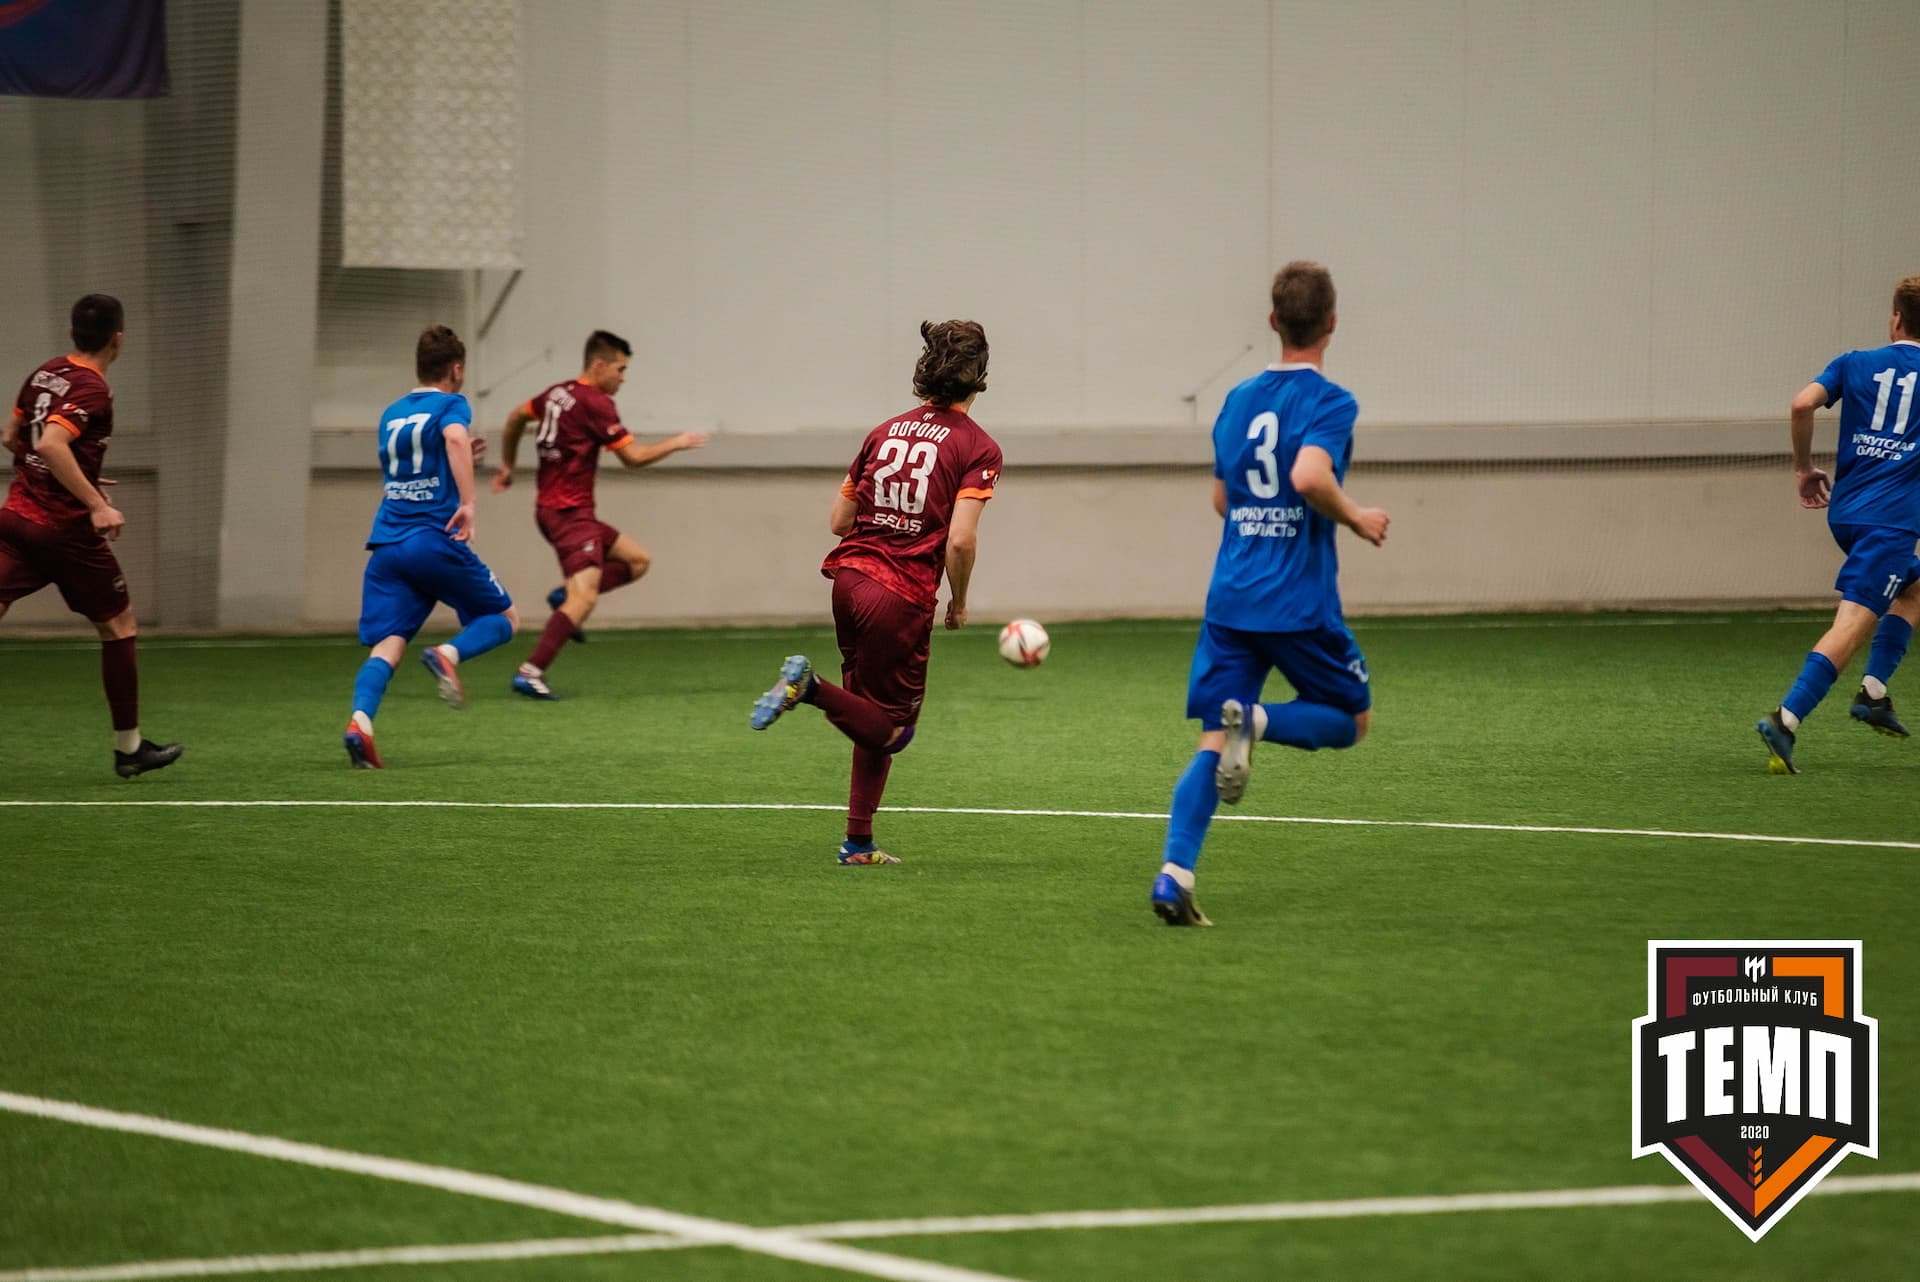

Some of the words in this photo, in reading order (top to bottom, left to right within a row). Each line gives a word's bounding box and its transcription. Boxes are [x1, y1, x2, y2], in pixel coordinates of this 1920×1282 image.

[888, 420, 951, 444] ВОРОНА
[1870, 367, 1918, 435] 11
[387, 413, 432, 478] 77
[873, 438, 938, 515] 23
[1246, 410, 1280, 500] 3
[1230, 505, 1305, 522] ИРКУТСКАЯ
